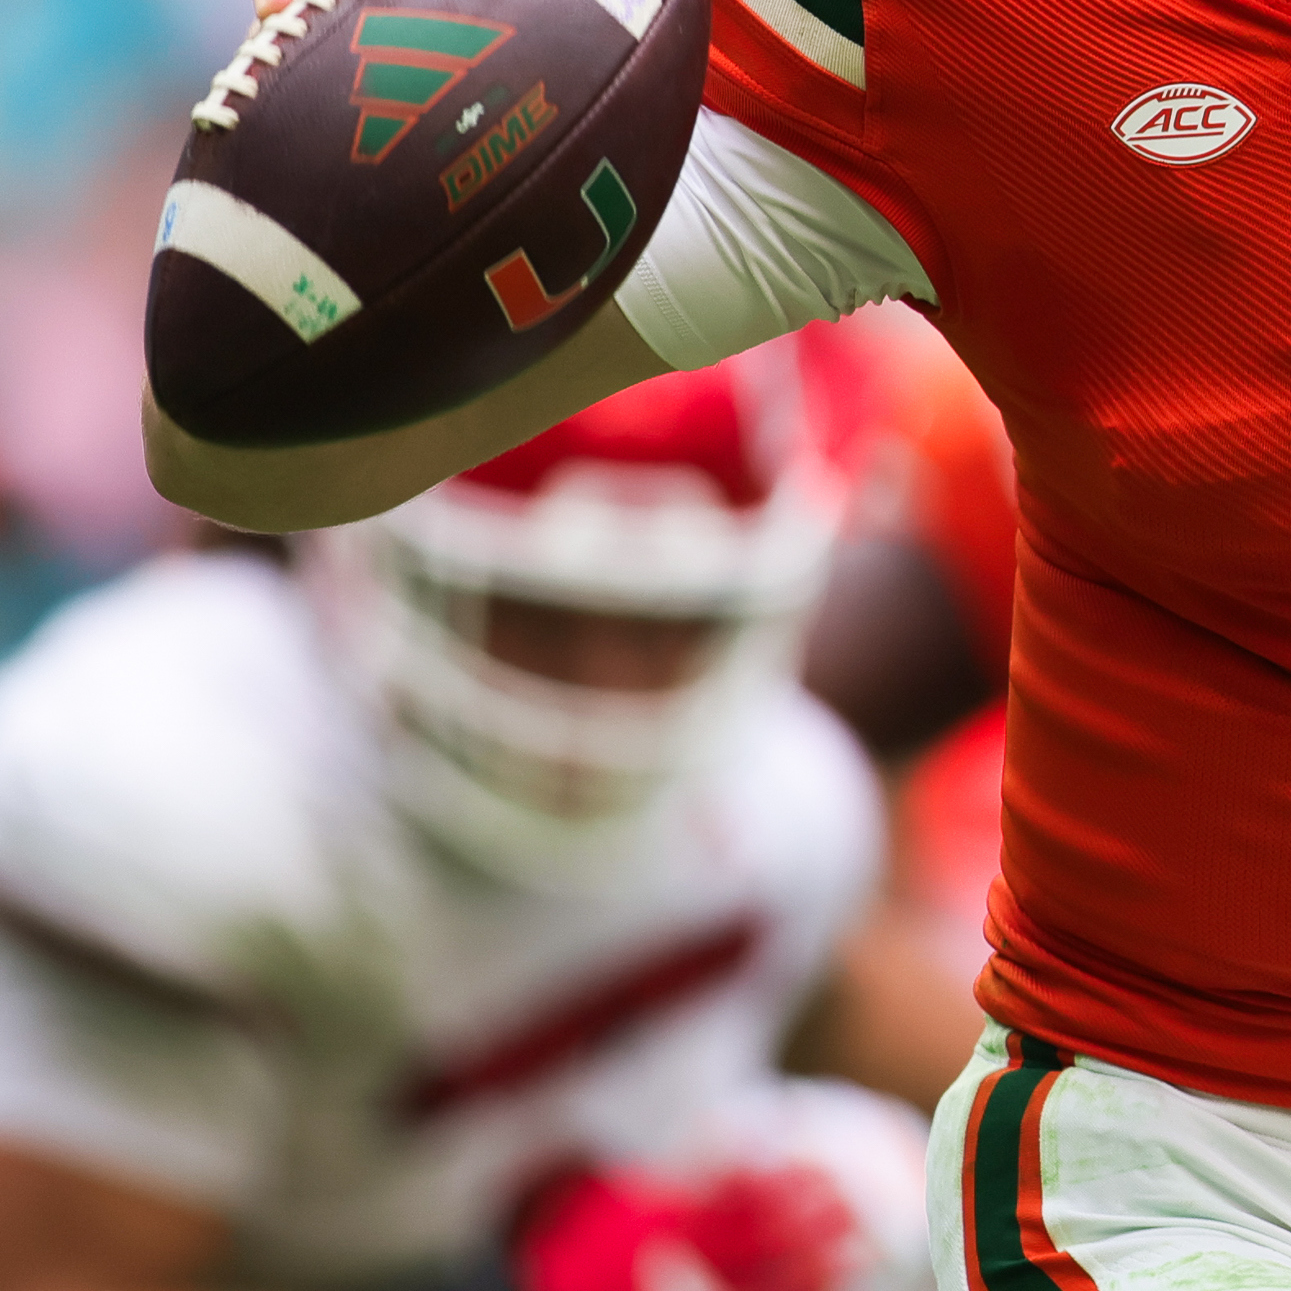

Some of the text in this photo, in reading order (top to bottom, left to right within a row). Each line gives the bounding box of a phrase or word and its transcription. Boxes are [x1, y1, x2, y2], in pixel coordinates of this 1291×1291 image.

[439, 79, 560, 215] DIME
[1135, 105, 1234, 136] ACC
[485, 156, 637, 332] U
